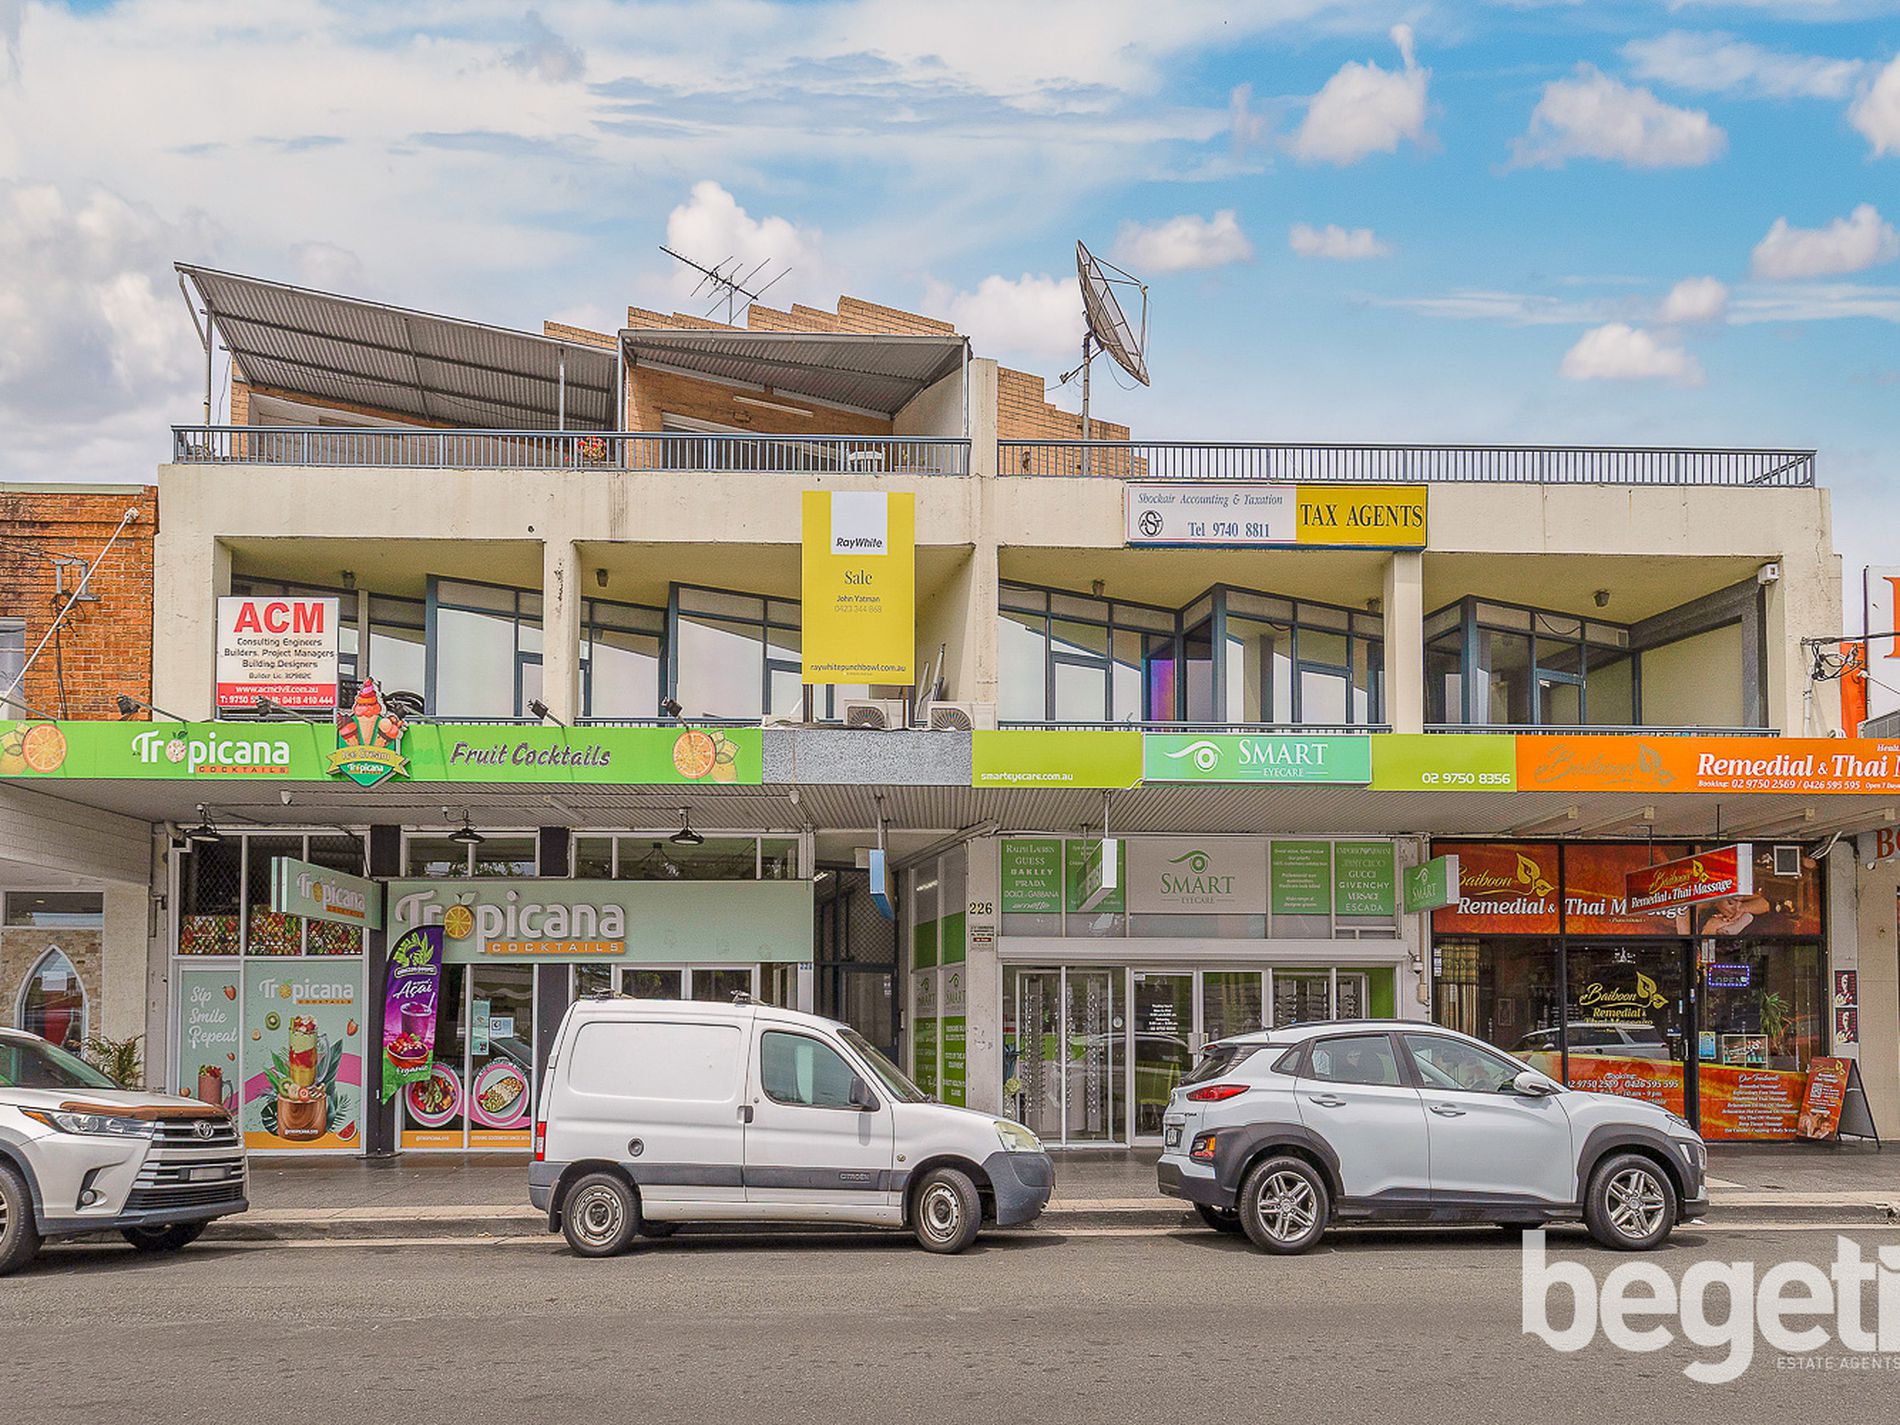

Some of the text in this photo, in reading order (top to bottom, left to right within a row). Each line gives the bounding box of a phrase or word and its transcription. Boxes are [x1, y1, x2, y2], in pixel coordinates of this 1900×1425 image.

[1180, 494, 1229, 507] Accounting
[1232, 494, 1240, 505] &
[1244, 494, 1283, 505] Taxation
[1300, 504, 1423, 528] TAX AGENTS
[1188, 522, 1269, 538] Tel 9740 8811
[836, 537, 883, 549] RayWhite
[844, 569, 873, 585] Sale
[836, 594, 854, 603] John
[233, 602, 324, 633] ACM
[237, 638, 322, 648] Consulting Engineers
[262, 648, 291, 658] Project
[294, 649, 335, 658] Managers
[242, 660, 318, 669] Building Designers
[810, 662, 906, 674] raywhitepunchbowl.com.au
[220, 695, 228, 704] T:
[229, 695, 249, 704] 9750
[132, 730, 290, 773] Tropicana
[450, 742, 611, 767] Fruit Cocktails
[1239, 739, 1328, 765] SMART
[1696, 753, 1813, 777] Remedial
[1817, 762, 1828, 775] &
[1832, 754, 1888, 777] Thai
[981, 772, 1073, 783] smarteyecare.com.au
[1264, 768, 1304, 777] EYECARE
[1422, 773, 1510, 785] 02 9750 8356
[1731, 779, 1744, 789] 02
[1746, 779, 1769, 789] 9750
[1771, 779, 1796, 790] 2569
[1803, 780, 1825, 790] 0426
[1827, 780, 1843, 790] 595
[1844, 781, 1860, 790] 595
[1874, 828, 1900, 859] B
[1015, 857, 1045, 865] GUESS
[1011, 868, 1054, 876] OAKLEY
[1348, 870, 1377, 878] GUCCI
[1160, 872, 1235, 894] SMART
[1338, 881, 1390, 889] GIVENCHY
[297, 871, 365, 912] Tropicana
[1631, 890, 1668, 909] Remedial
[1672, 886, 1692, 901] Thai
[1693, 878, 1733, 896] Massage
[970, 902, 992, 915] 226
[1345, 903, 1384, 911] ESCADA
[1457, 897, 1545, 914] Remedial
[1547, 903, 1556, 913] &
[1564, 898, 1606, 915] Thai
[395, 889, 625, 953] Tropicana
[492, 943, 619, 952] COCKTAILS
[190, 986, 212, 1005] Sip
[259, 978, 353, 1004] Tropicana
[1580, 982, 1637, 1005] Baiboon
[189, 1007, 227, 1025] Smile
[1593, 1008, 1640, 1018] Remedial
[189, 1025, 237, 1049] Repeat
[1647, 1080, 1661, 1088] 595
[1663, 1080, 1678, 1088] 595
